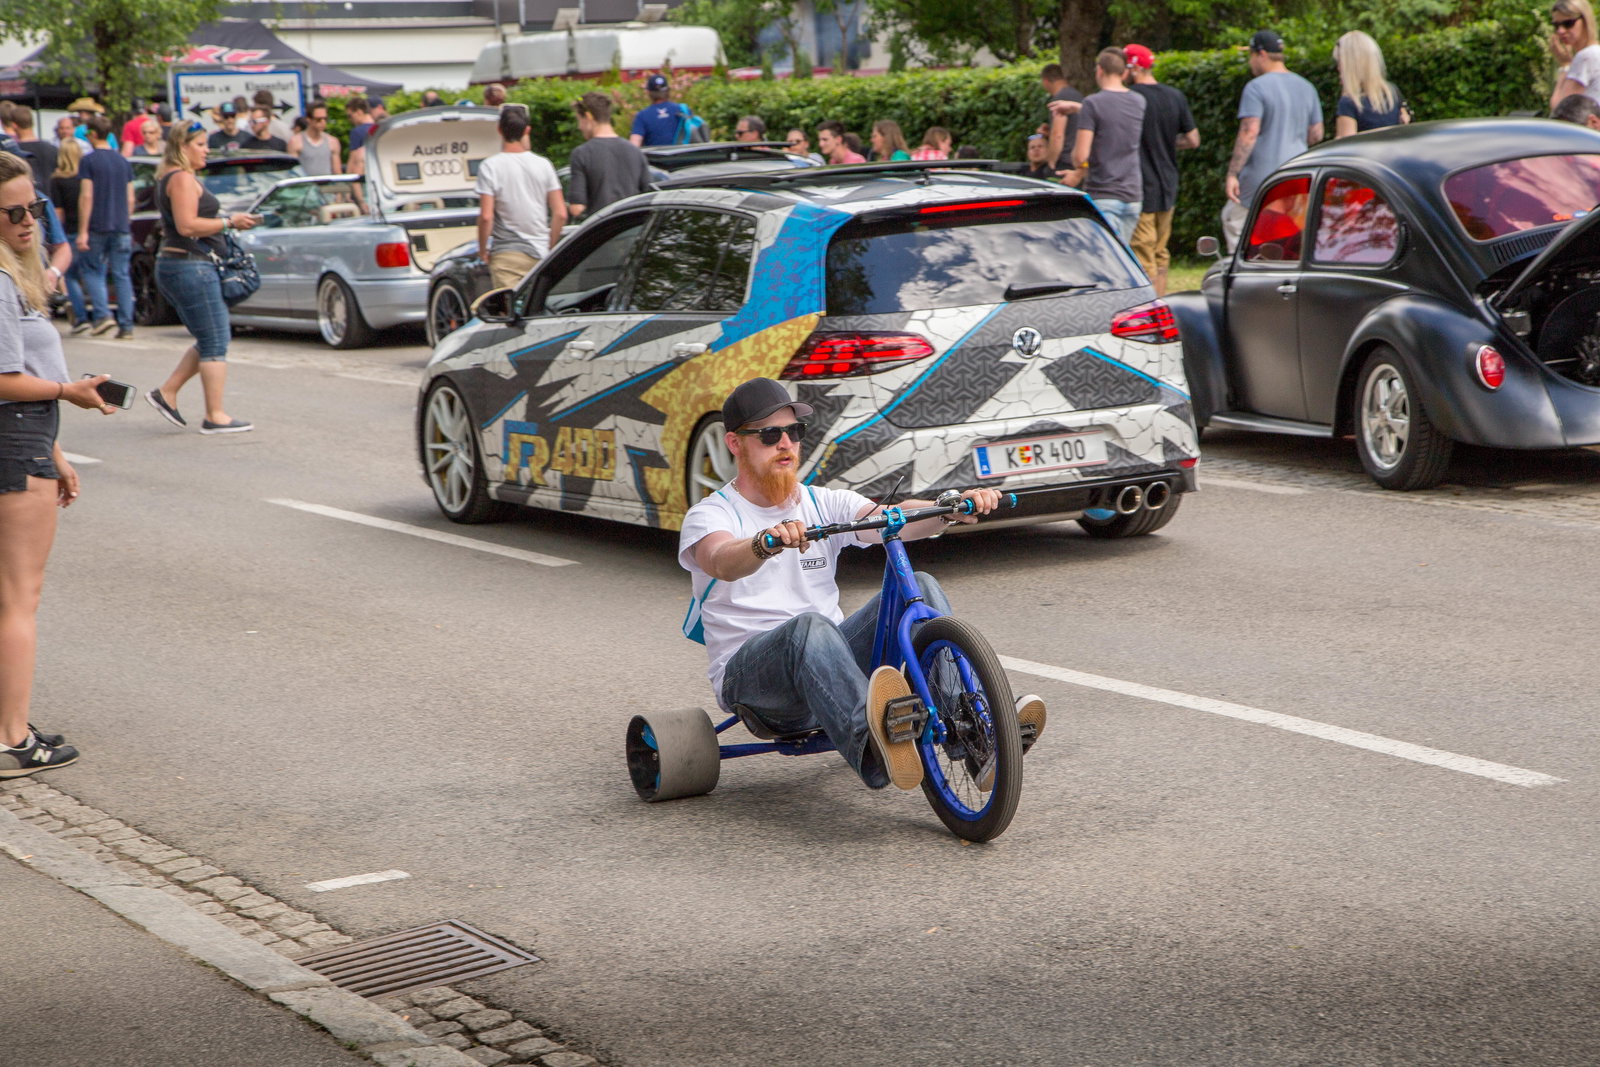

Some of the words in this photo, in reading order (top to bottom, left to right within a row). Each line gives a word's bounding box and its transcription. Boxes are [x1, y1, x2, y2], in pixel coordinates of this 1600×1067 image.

[413, 143, 448, 156] Audi
[451, 141, 469, 154] 80
[551, 426, 616, 482] 400
[1051, 438, 1086, 463] 400
[32, 748, 53, 763] N
